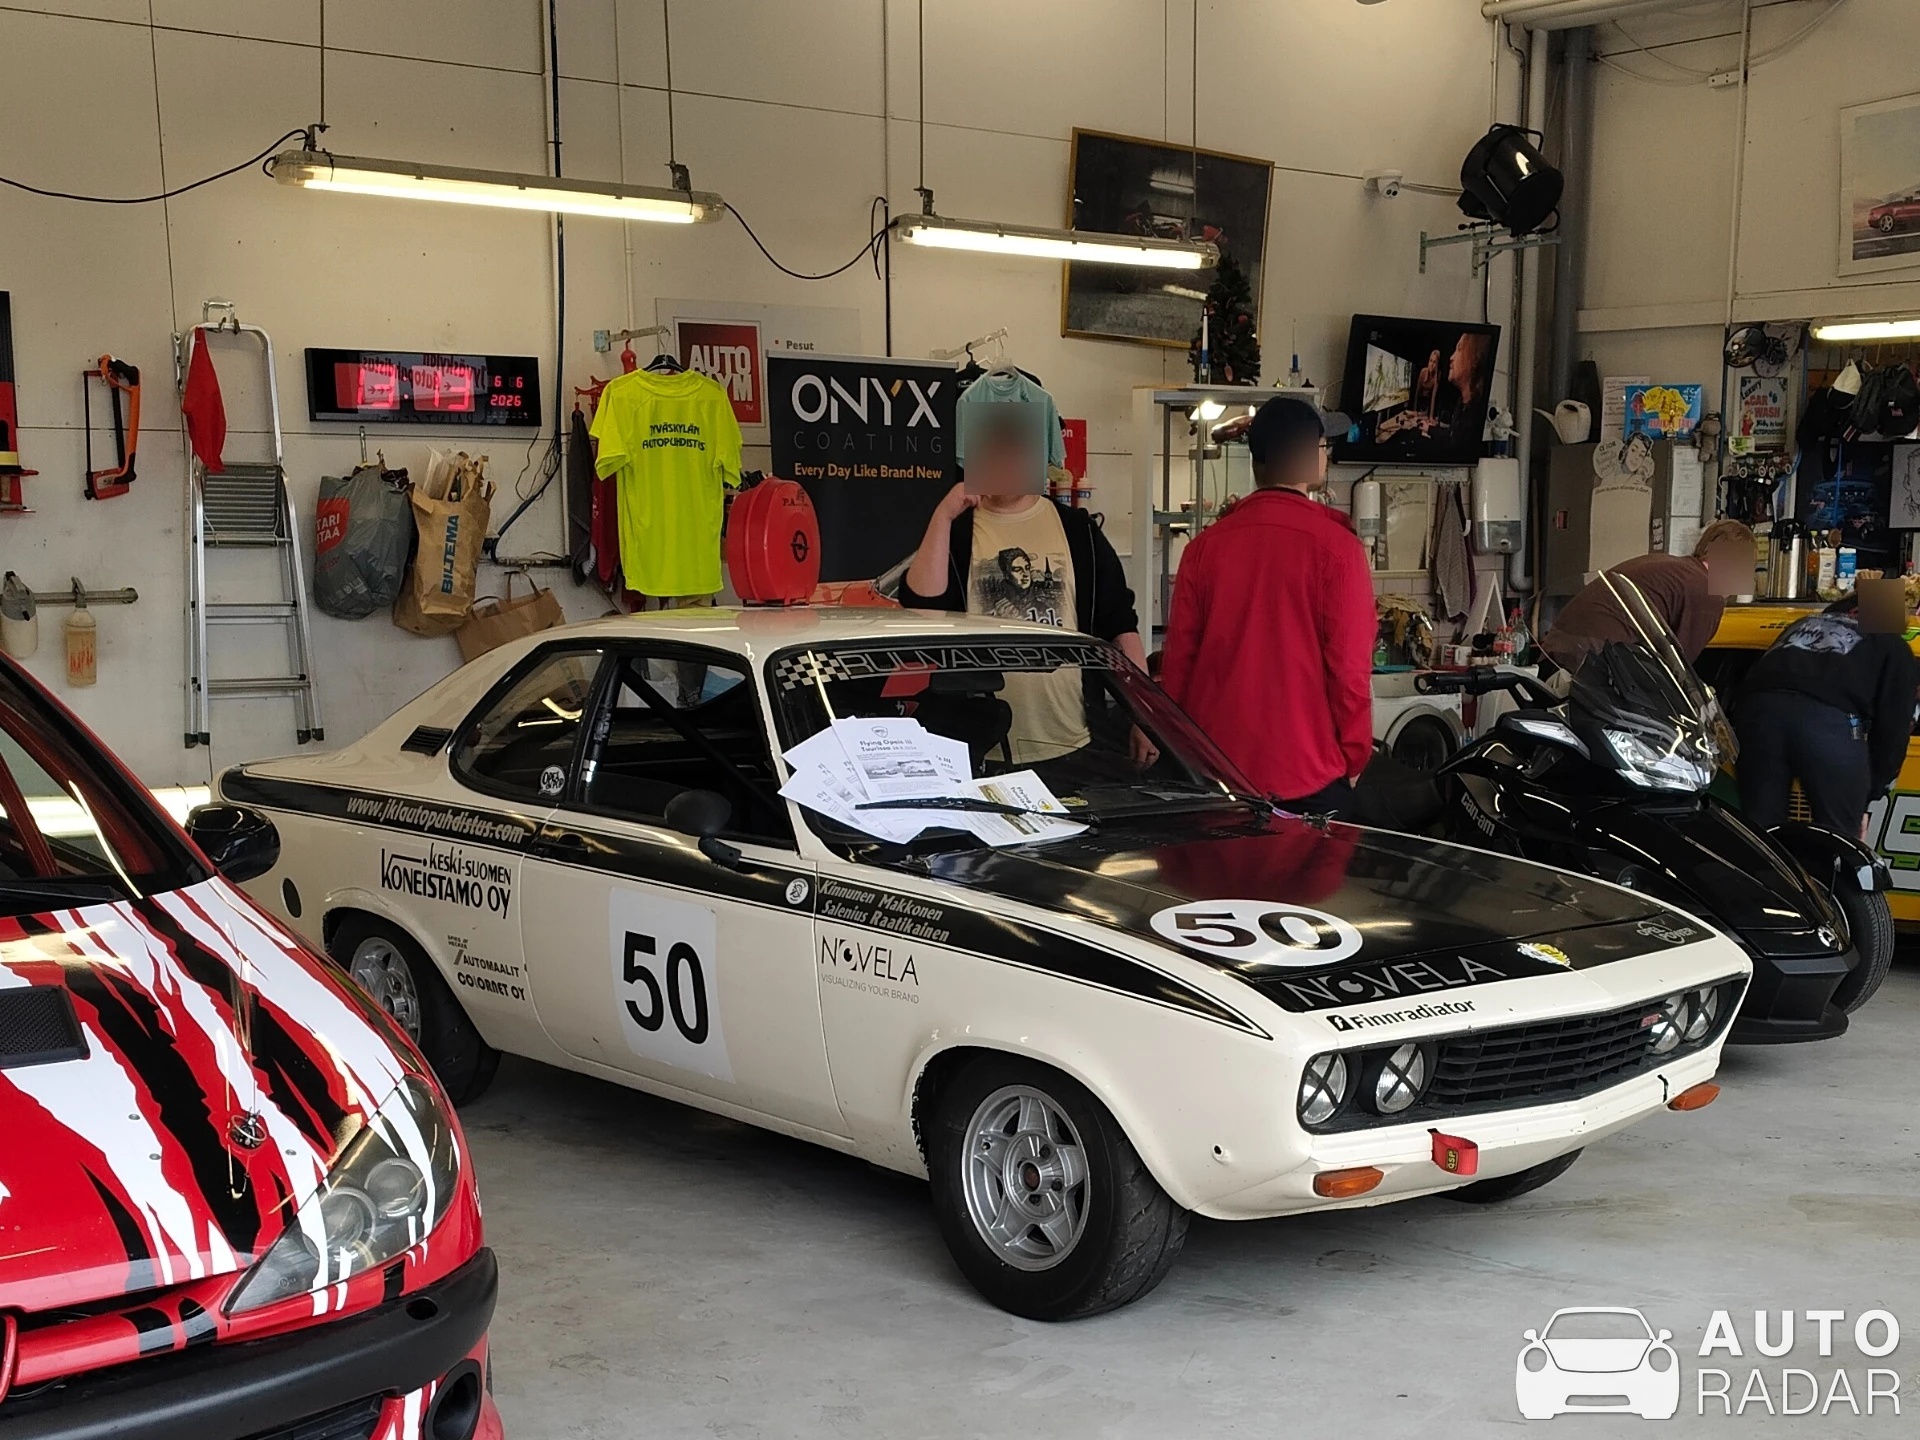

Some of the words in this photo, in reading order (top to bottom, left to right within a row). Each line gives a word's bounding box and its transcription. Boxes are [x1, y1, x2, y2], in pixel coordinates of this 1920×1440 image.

[689, 344, 752, 377] AUTO
[786, 340, 815, 351] Pesut
[490, 395, 522, 407] 2026
[791, 374, 942, 428] ONYX
[1750, 394, 1768, 406] CAR
[1754, 407, 1780, 418] WASH
[794, 431, 942, 454] COATING
[794, 463, 825, 479] Every
[827, 463, 851, 479] Day
[853, 464, 878, 477] Like
[880, 465, 914, 478] Brand
[916, 466, 943, 478] New
[441, 515, 460, 594] BILTEMA
[346, 796, 525, 845] www.jklautopuhdistus.com
[1461, 792, 1496, 837] can-am
[487, 885, 511, 920] OY
[818, 879, 875, 904] Kinnunen
[878, 892, 944, 922] Makkonen
[821, 899, 868, 923] Salenius
[869, 910, 950, 943] Raatikainen
[1174, 911, 1343, 951] 50
[463, 954, 520, 978] AUTOMAALIT
[821, 935, 919, 986] NOVELA
[511, 985, 526, 1001] OY
[623, 930, 709, 1045] 50
[821, 973, 867, 993] VISUALIZING
[867, 983, 890, 998] YOUR
[891, 989, 919, 1004] BRAND
[1281, 955, 1508, 1008] NOVELA
[1349, 999, 1477, 1030] Finnradiator
[1447, 1150, 1456, 1169] QSP
